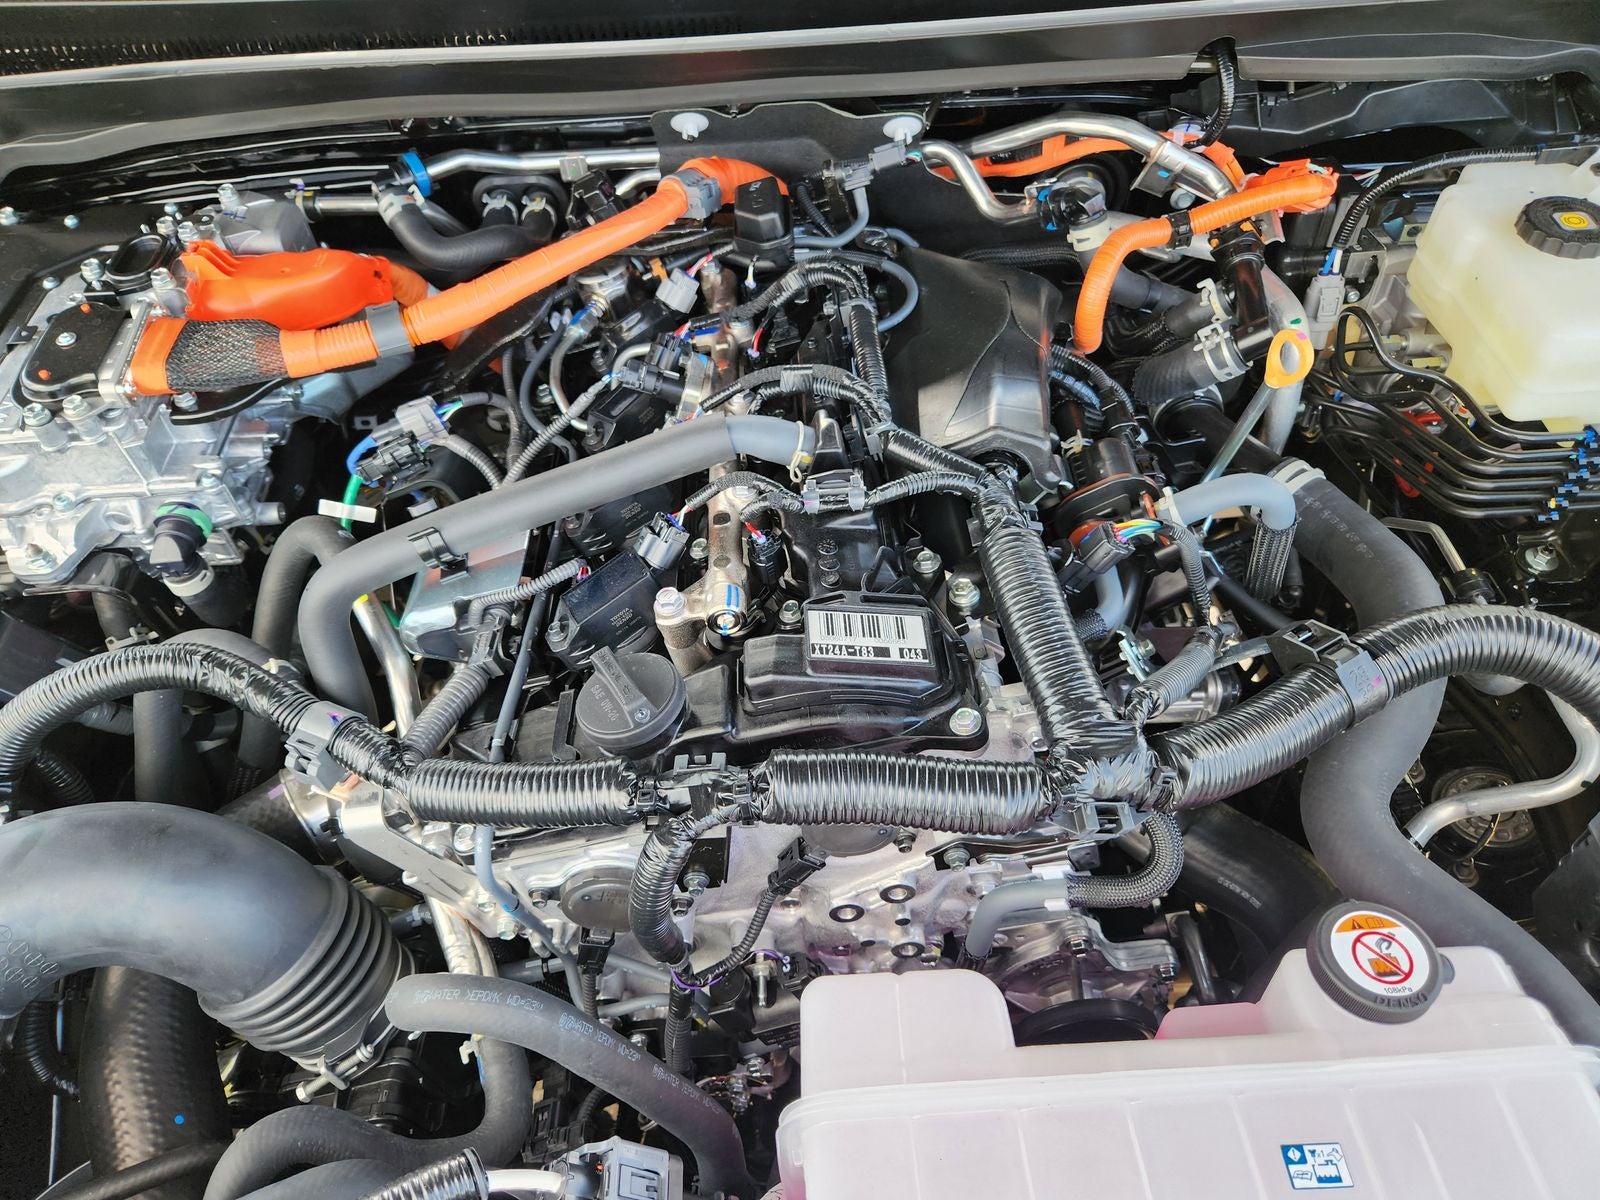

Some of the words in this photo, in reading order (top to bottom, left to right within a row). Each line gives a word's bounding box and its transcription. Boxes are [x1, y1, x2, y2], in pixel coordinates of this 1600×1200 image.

[610, 607, 630, 621] TOYOTA
[813, 644, 875, 657] XT24A-T83
[903, 648, 923, 660] 043
[591, 684, 604, 700] SAE
[1384, 986, 1413, 994] 108kPa
